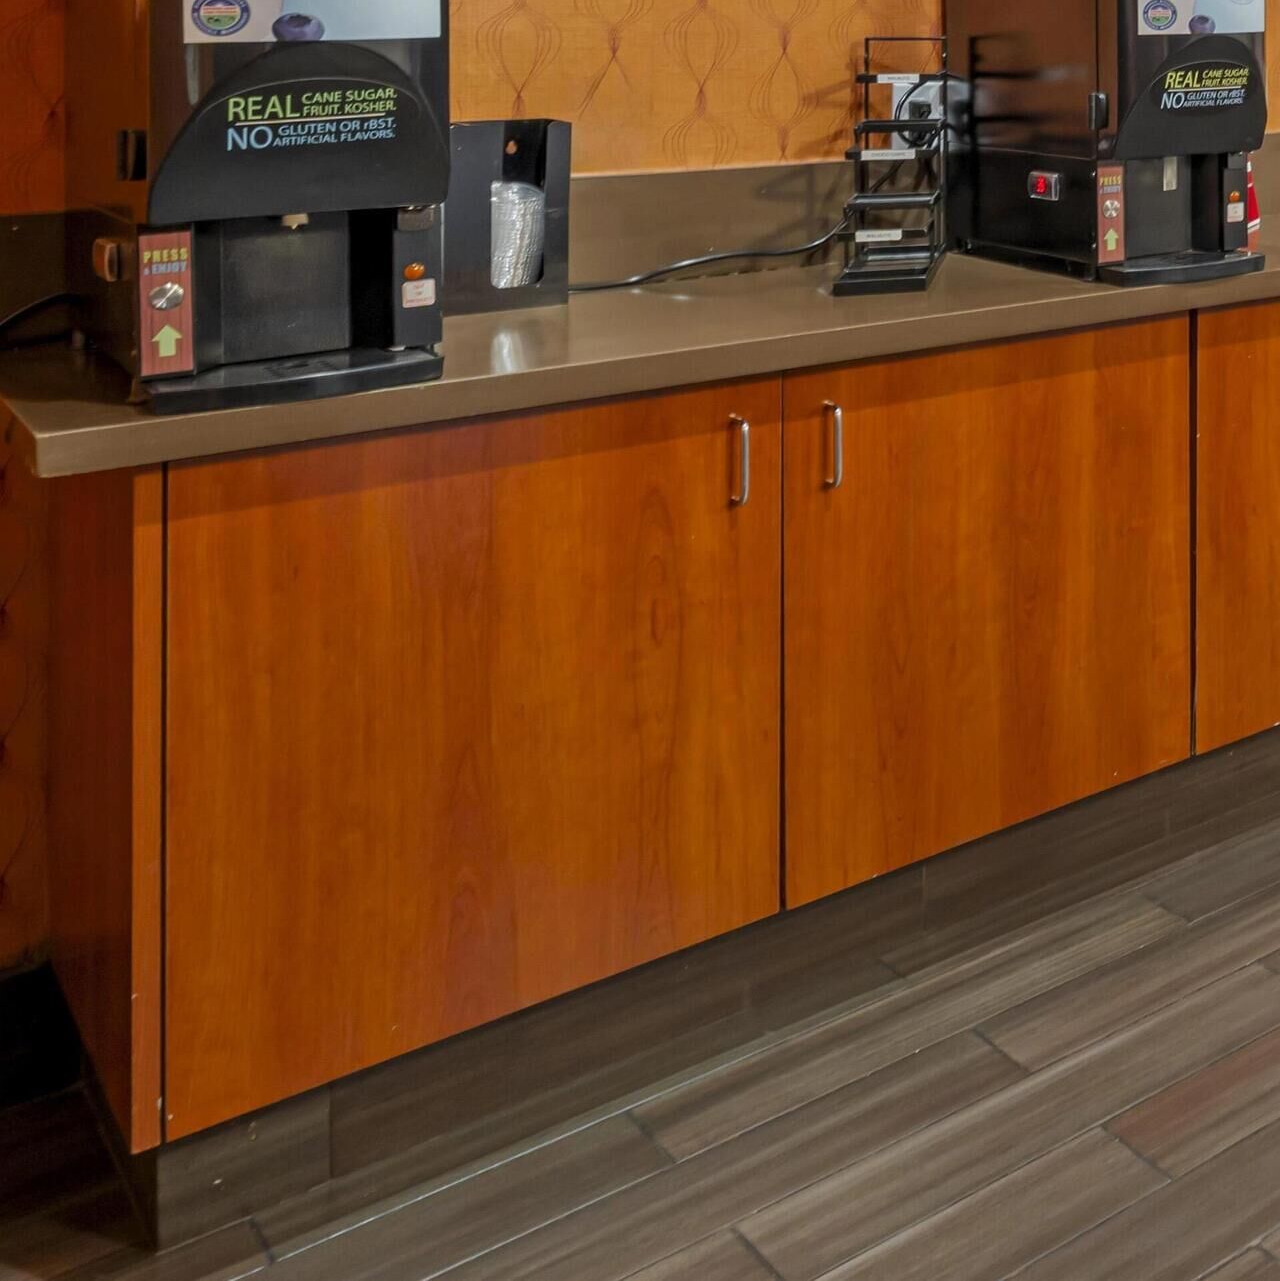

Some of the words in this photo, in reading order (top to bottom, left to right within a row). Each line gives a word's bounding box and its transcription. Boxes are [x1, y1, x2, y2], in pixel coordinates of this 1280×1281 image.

[1165, 70, 1200, 89] REAL
[1202, 69, 1222, 79] CANE
[228, 94, 300, 122] REAL
[301, 93, 342, 104] CANE
[345, 88, 398, 102] SUGAR.
[303, 104, 342, 117] FRUIT.
[344, 100, 397, 114] KOSHER.
[1160, 92, 1185, 109] NO
[1187, 91, 1216, 100] GLUTEN
[1217, 90, 1228, 98] OR
[1183, 99, 1216, 108] ARTIFICIAL
[227, 126, 273, 151] NO
[278, 122, 336, 136] GLUTEN
[339, 120, 360, 132] OR
[363, 117, 397, 130] rBST.
[272, 134, 337, 147] ARTIFICIAL
[340, 129, 395, 143] FLAVORS.
[143, 247, 188, 264] PRESS
